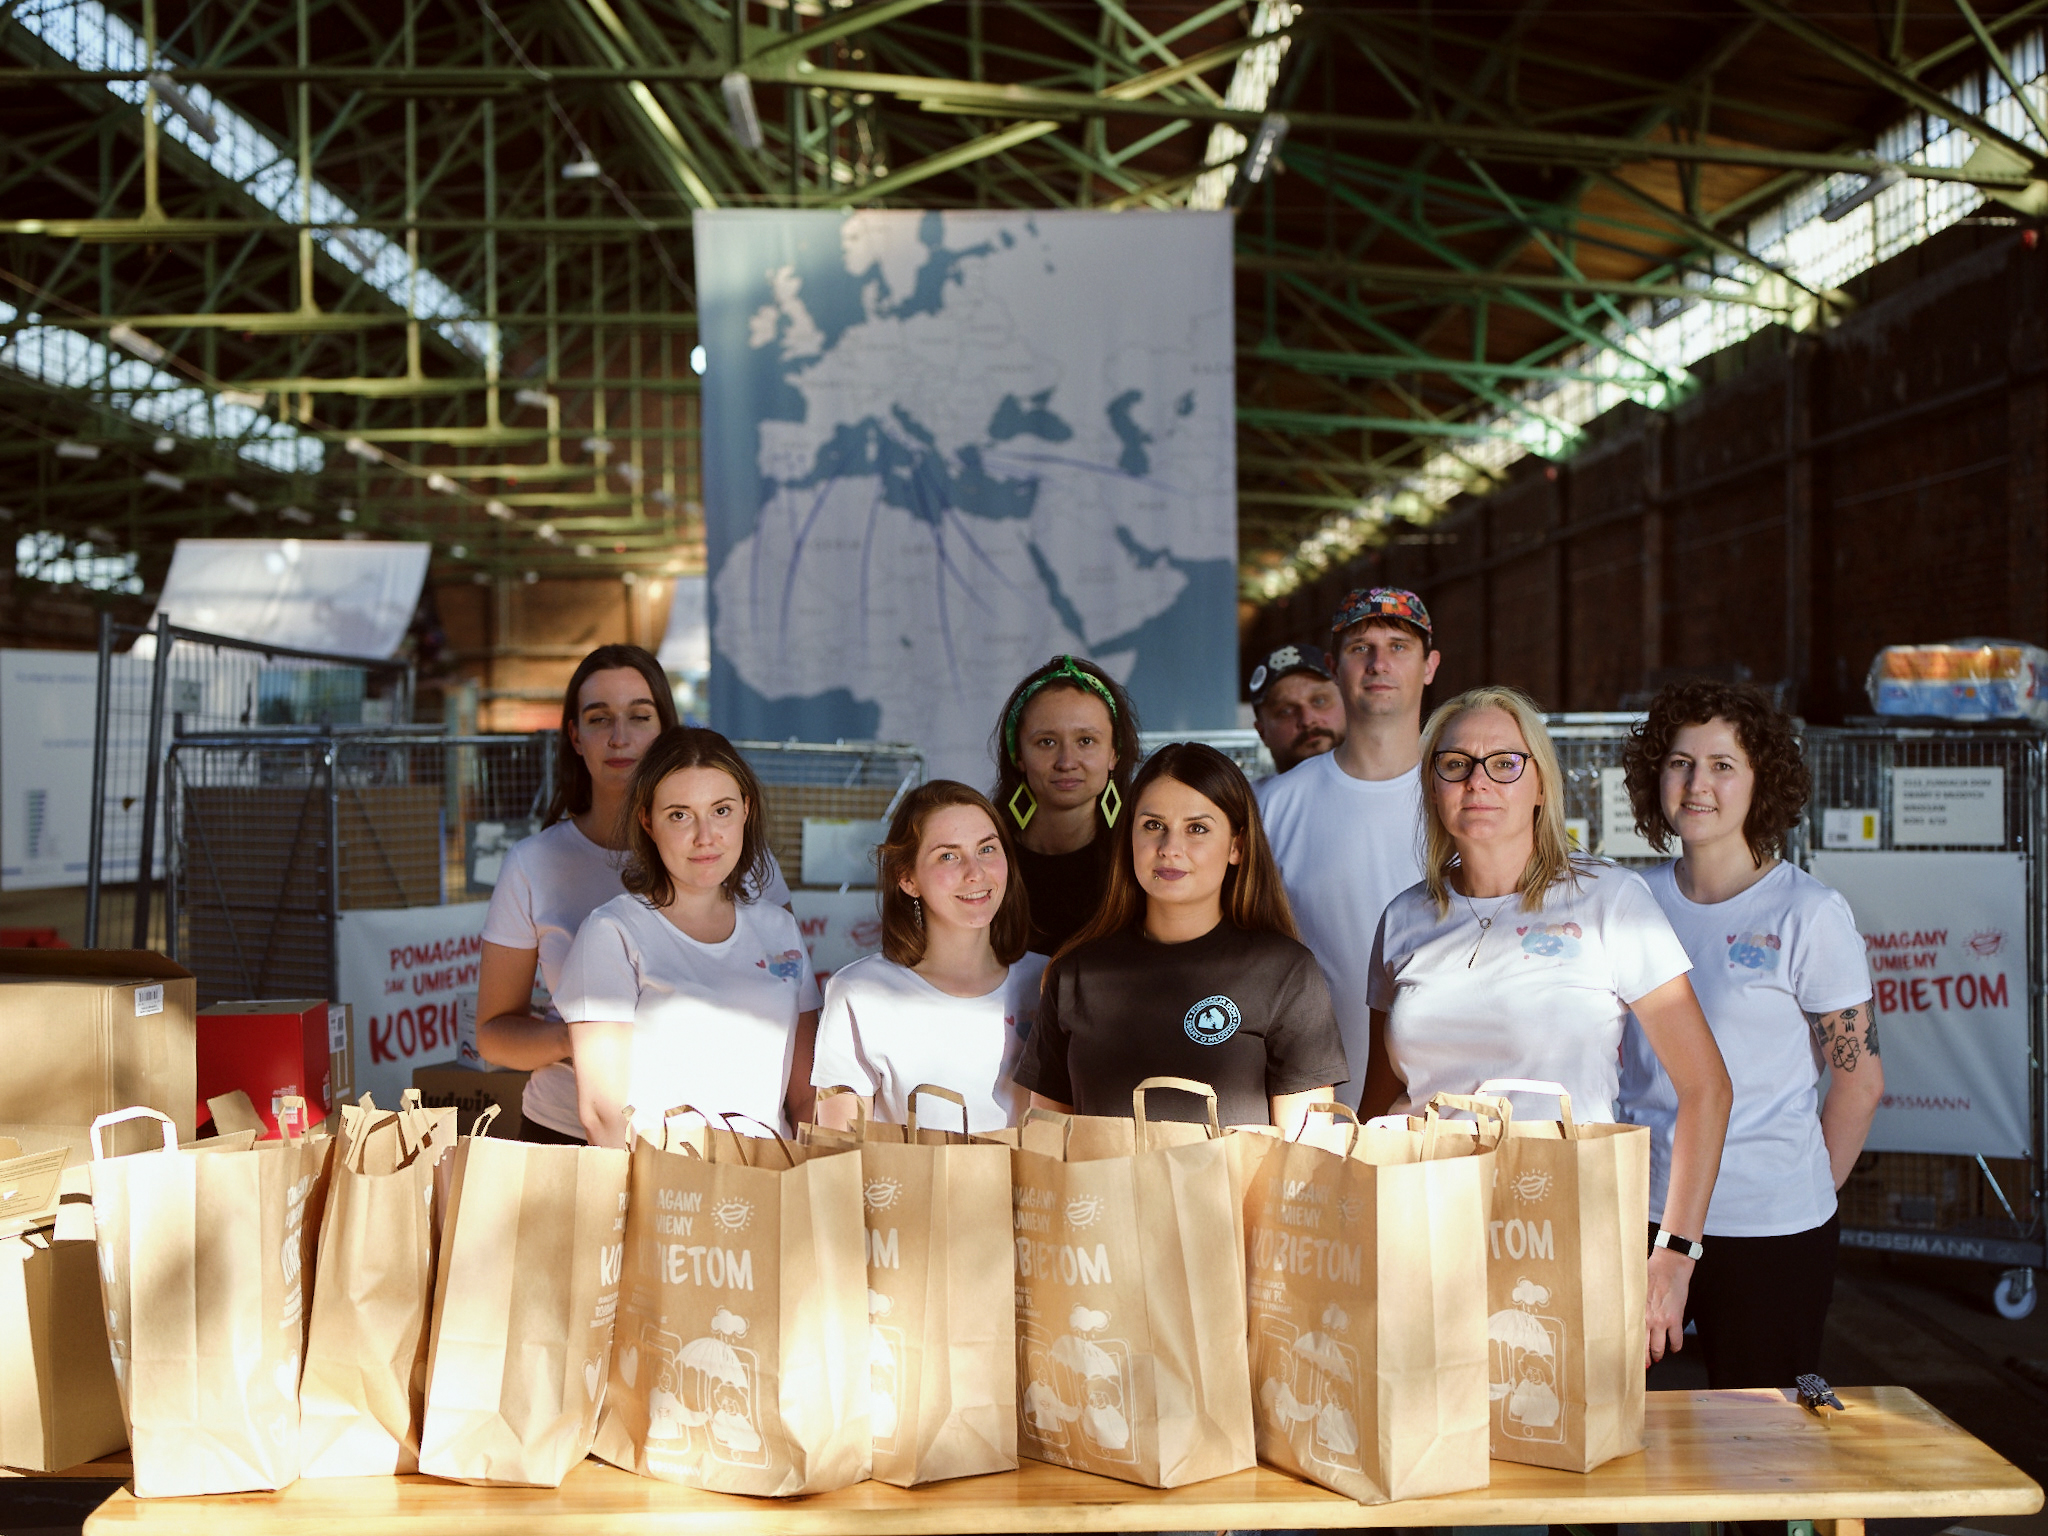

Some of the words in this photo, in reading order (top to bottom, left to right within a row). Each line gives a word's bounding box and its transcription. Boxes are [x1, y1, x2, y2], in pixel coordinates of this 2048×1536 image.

[1872, 952, 1938, 972] UMIEMY
[1873, 972, 2009, 1015] BIETOM
[1877, 1094, 1970, 1110] OSSMANN
[656, 1243, 754, 1292] IETOM
[1014, 1236, 1112, 1286] BIETOM
